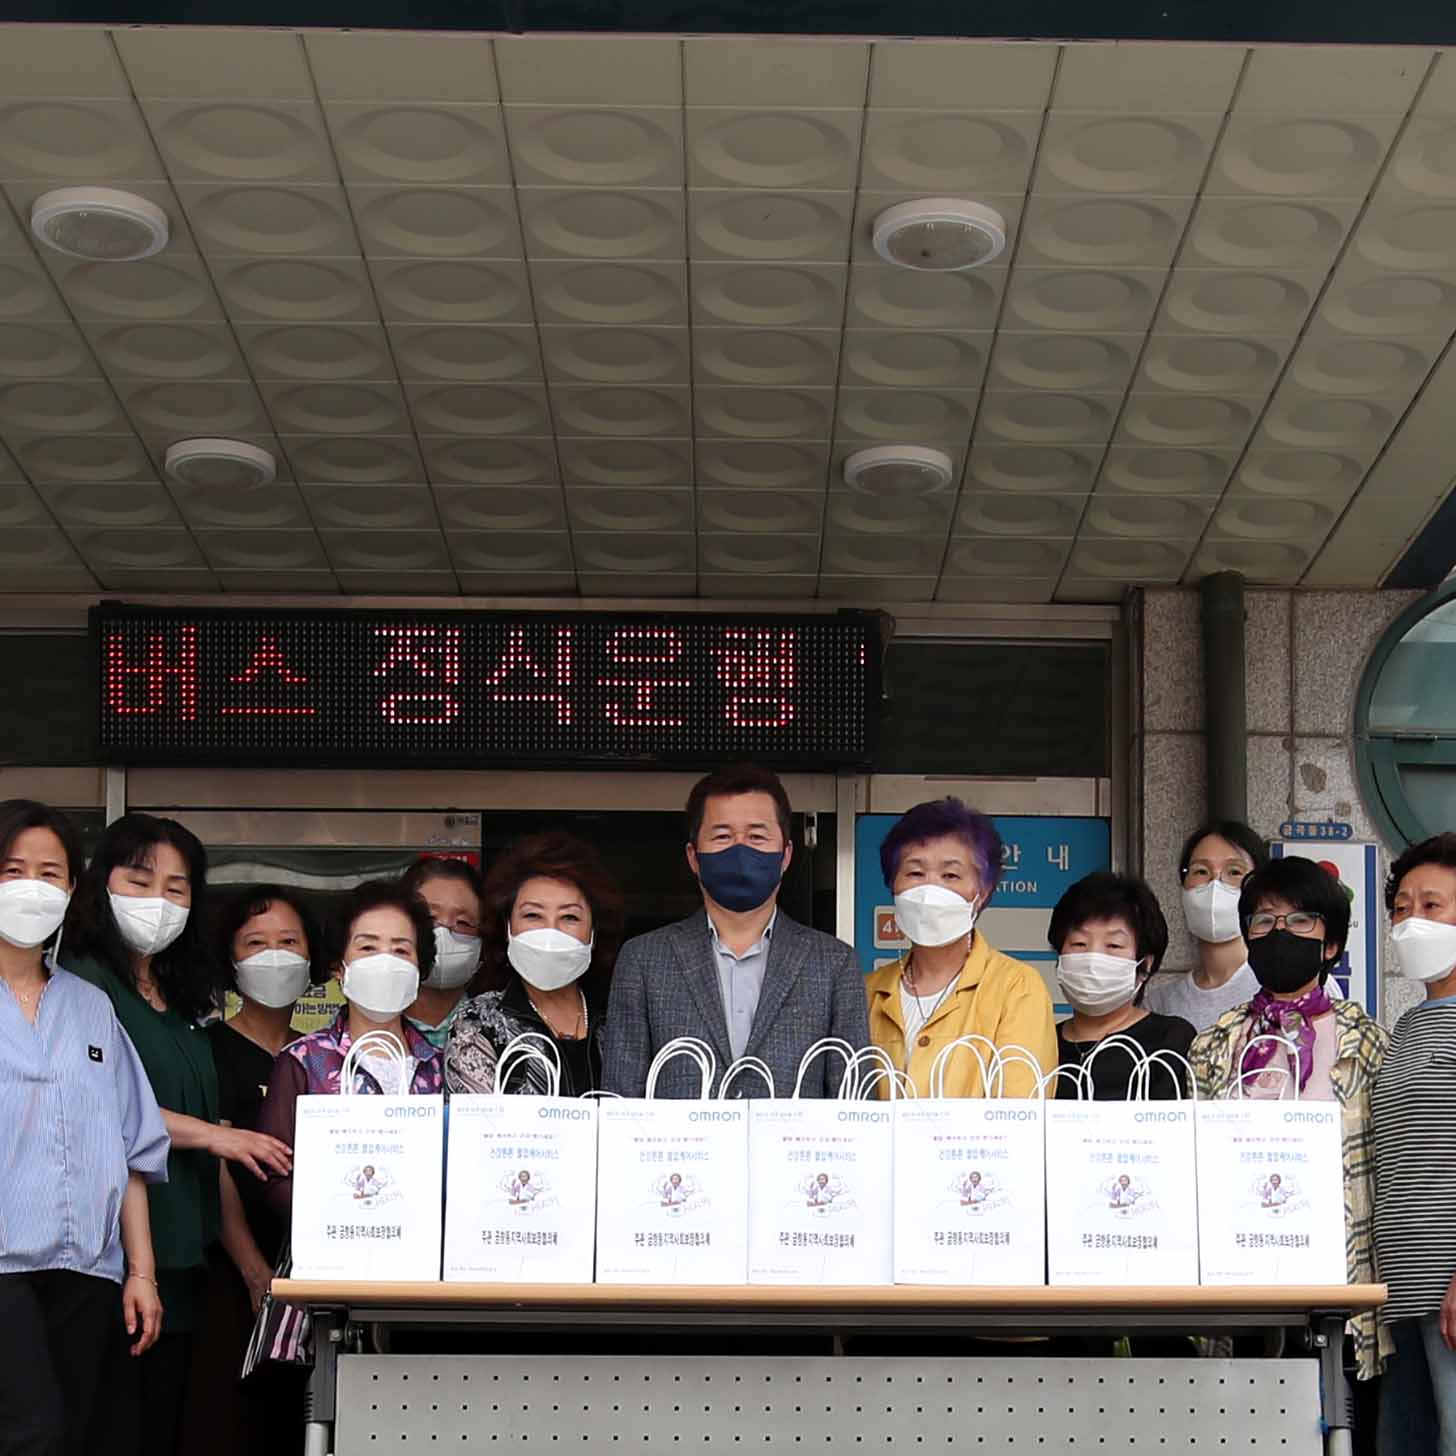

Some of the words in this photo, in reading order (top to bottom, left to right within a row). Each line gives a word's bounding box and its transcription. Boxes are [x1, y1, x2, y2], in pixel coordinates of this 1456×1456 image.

[107, 626, 316, 722] 버스
[372, 628, 795, 728] 정식운행
[995, 881, 1037, 893] TION
[383, 1105, 437, 1118] OMRON
[537, 1106, 591, 1121] OMRON
[688, 1111, 742, 1122] OMRON
[836, 1111, 890, 1124] OMRON
[983, 1109, 1038, 1122] OMRON
[1133, 1111, 1187, 1124] OMRON
[1282, 1111, 1334, 1124] OMRON
